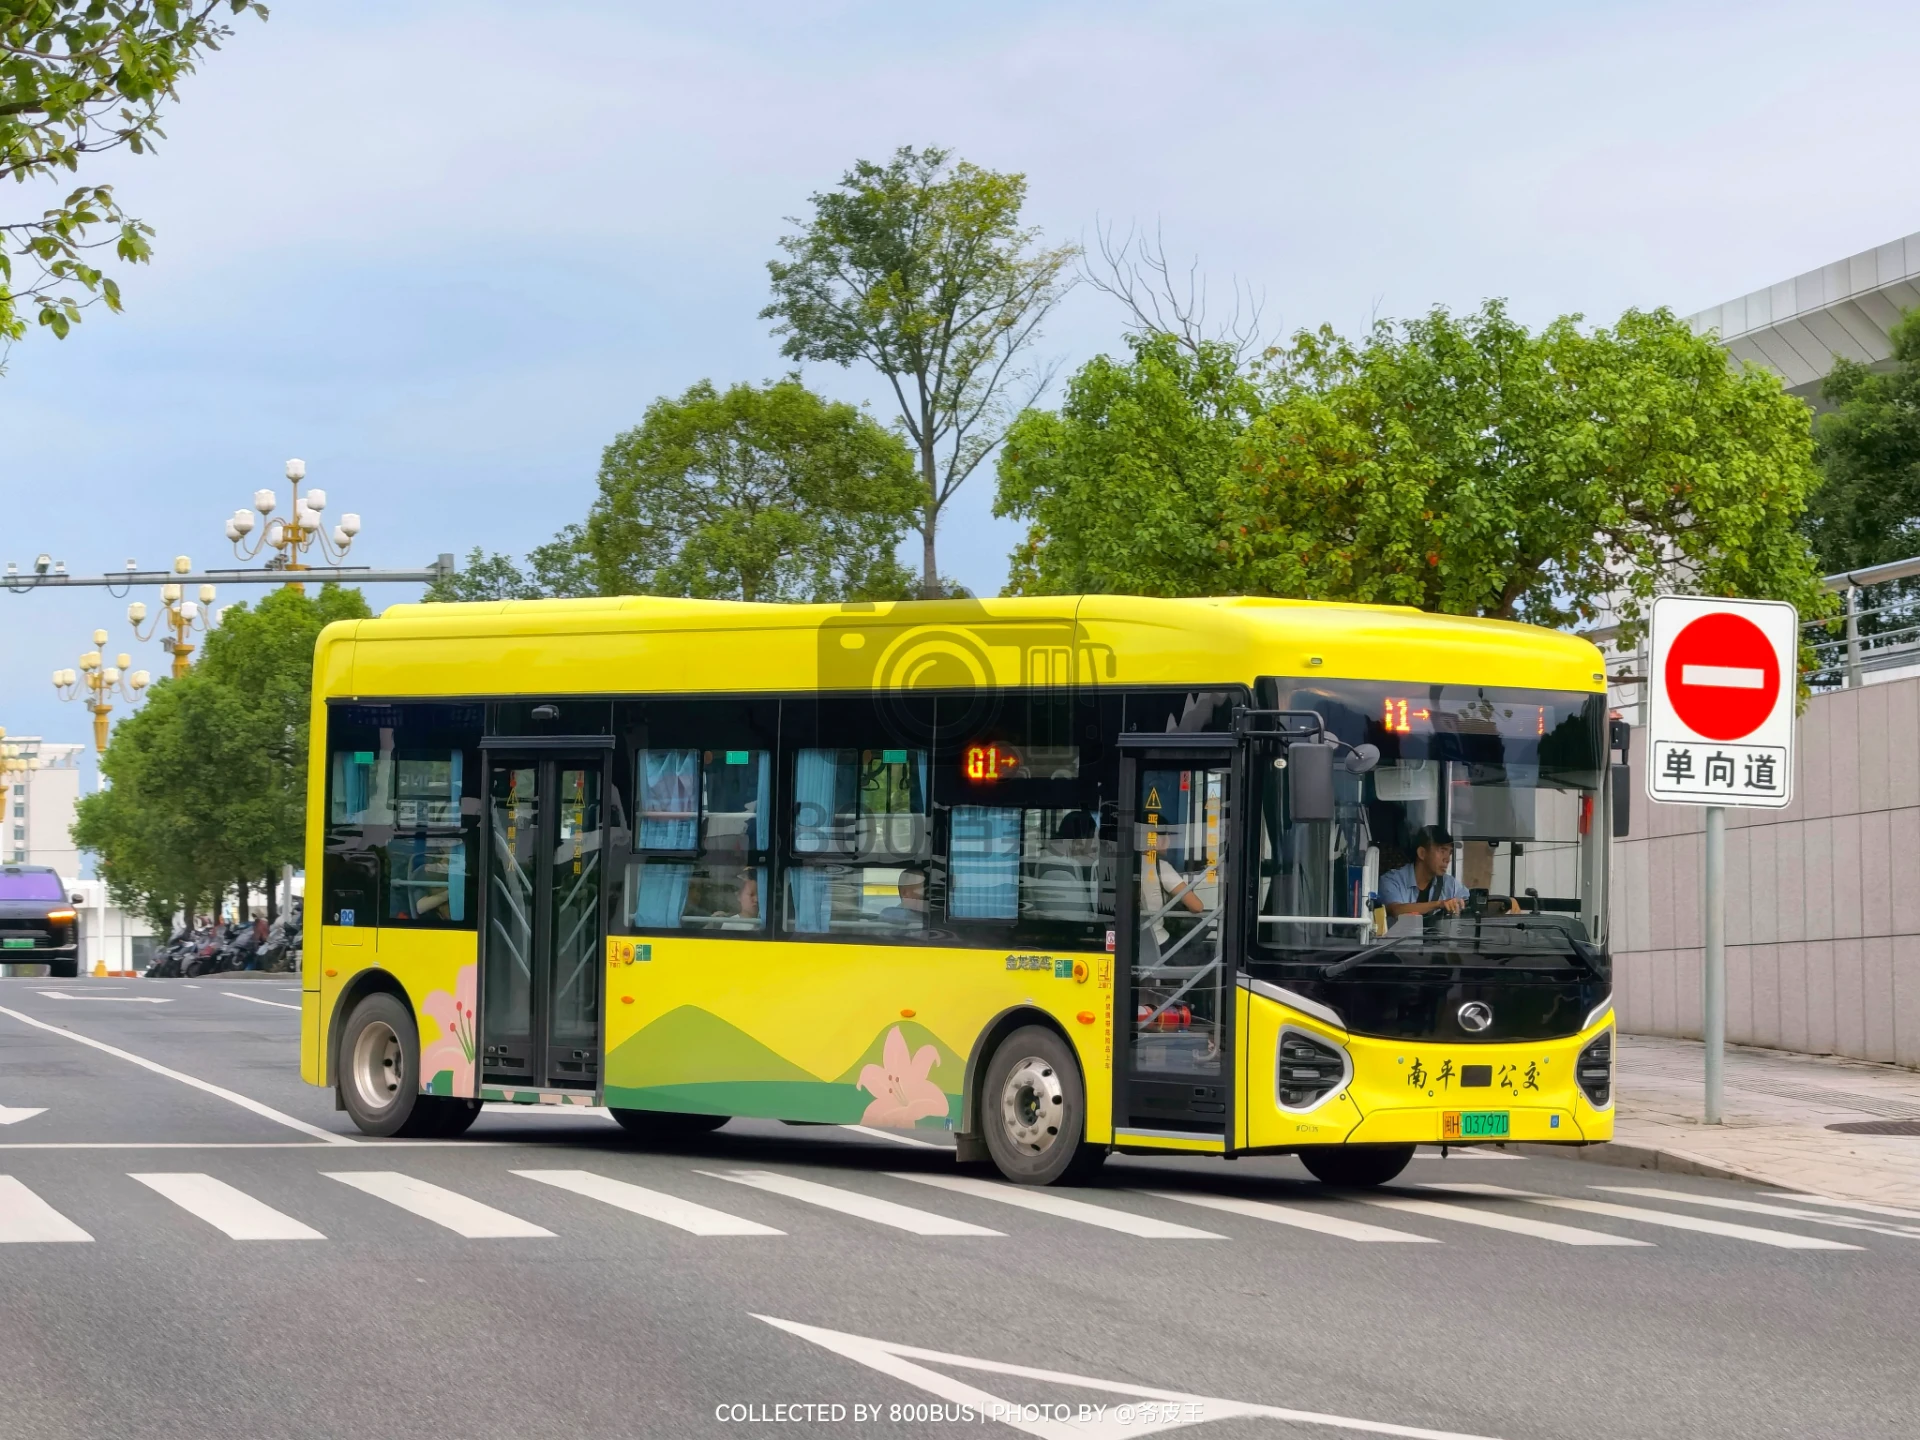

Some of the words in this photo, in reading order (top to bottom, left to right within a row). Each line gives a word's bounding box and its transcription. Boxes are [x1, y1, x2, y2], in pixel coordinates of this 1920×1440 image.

[968, 747, 998, 778] G1
[1662, 748, 1777, 791] 单向道
[1407, 1057, 1456, 1090] 南平
[1498, 1061, 1541, 1091] 公交
